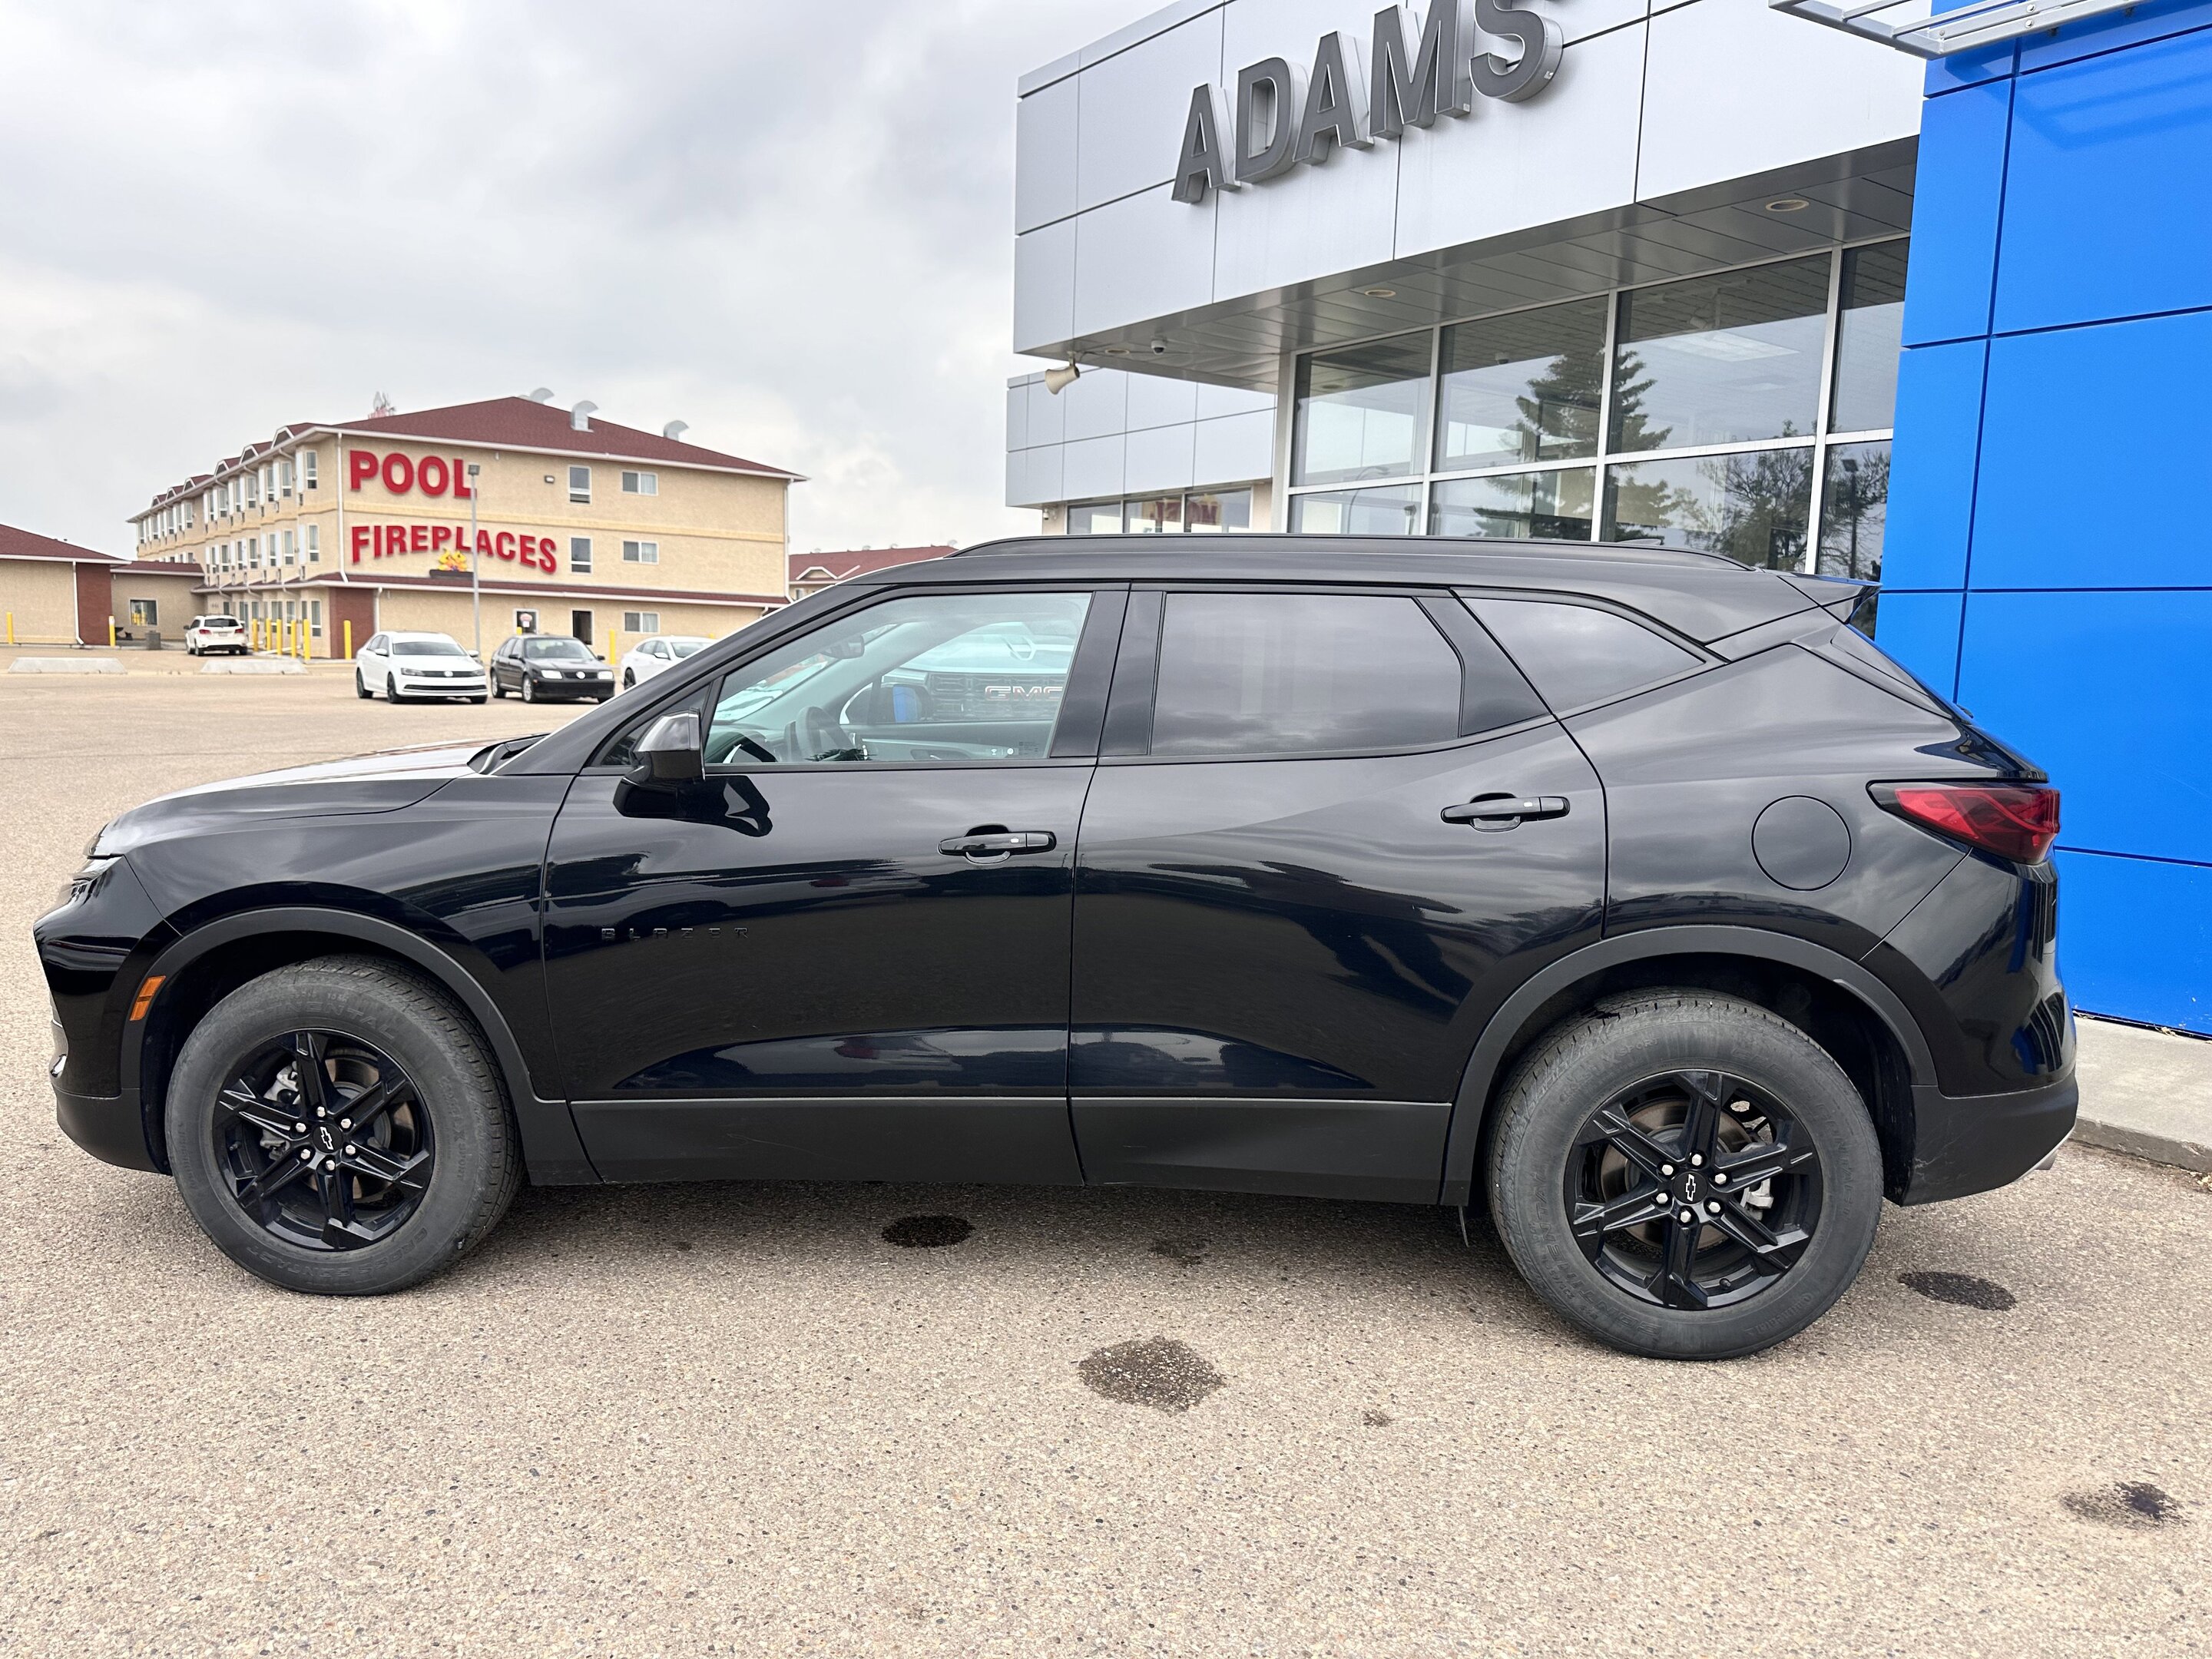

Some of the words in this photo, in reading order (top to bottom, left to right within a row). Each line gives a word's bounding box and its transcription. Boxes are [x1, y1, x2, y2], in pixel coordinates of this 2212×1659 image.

[1172, 0, 1562, 203] ADAMS
[349, 450, 477, 498] POOL
[351, 525, 557, 575] FIREPLACES
[985, 685, 1064, 701] GMC
[601, 927, 749, 941] BLAZER
